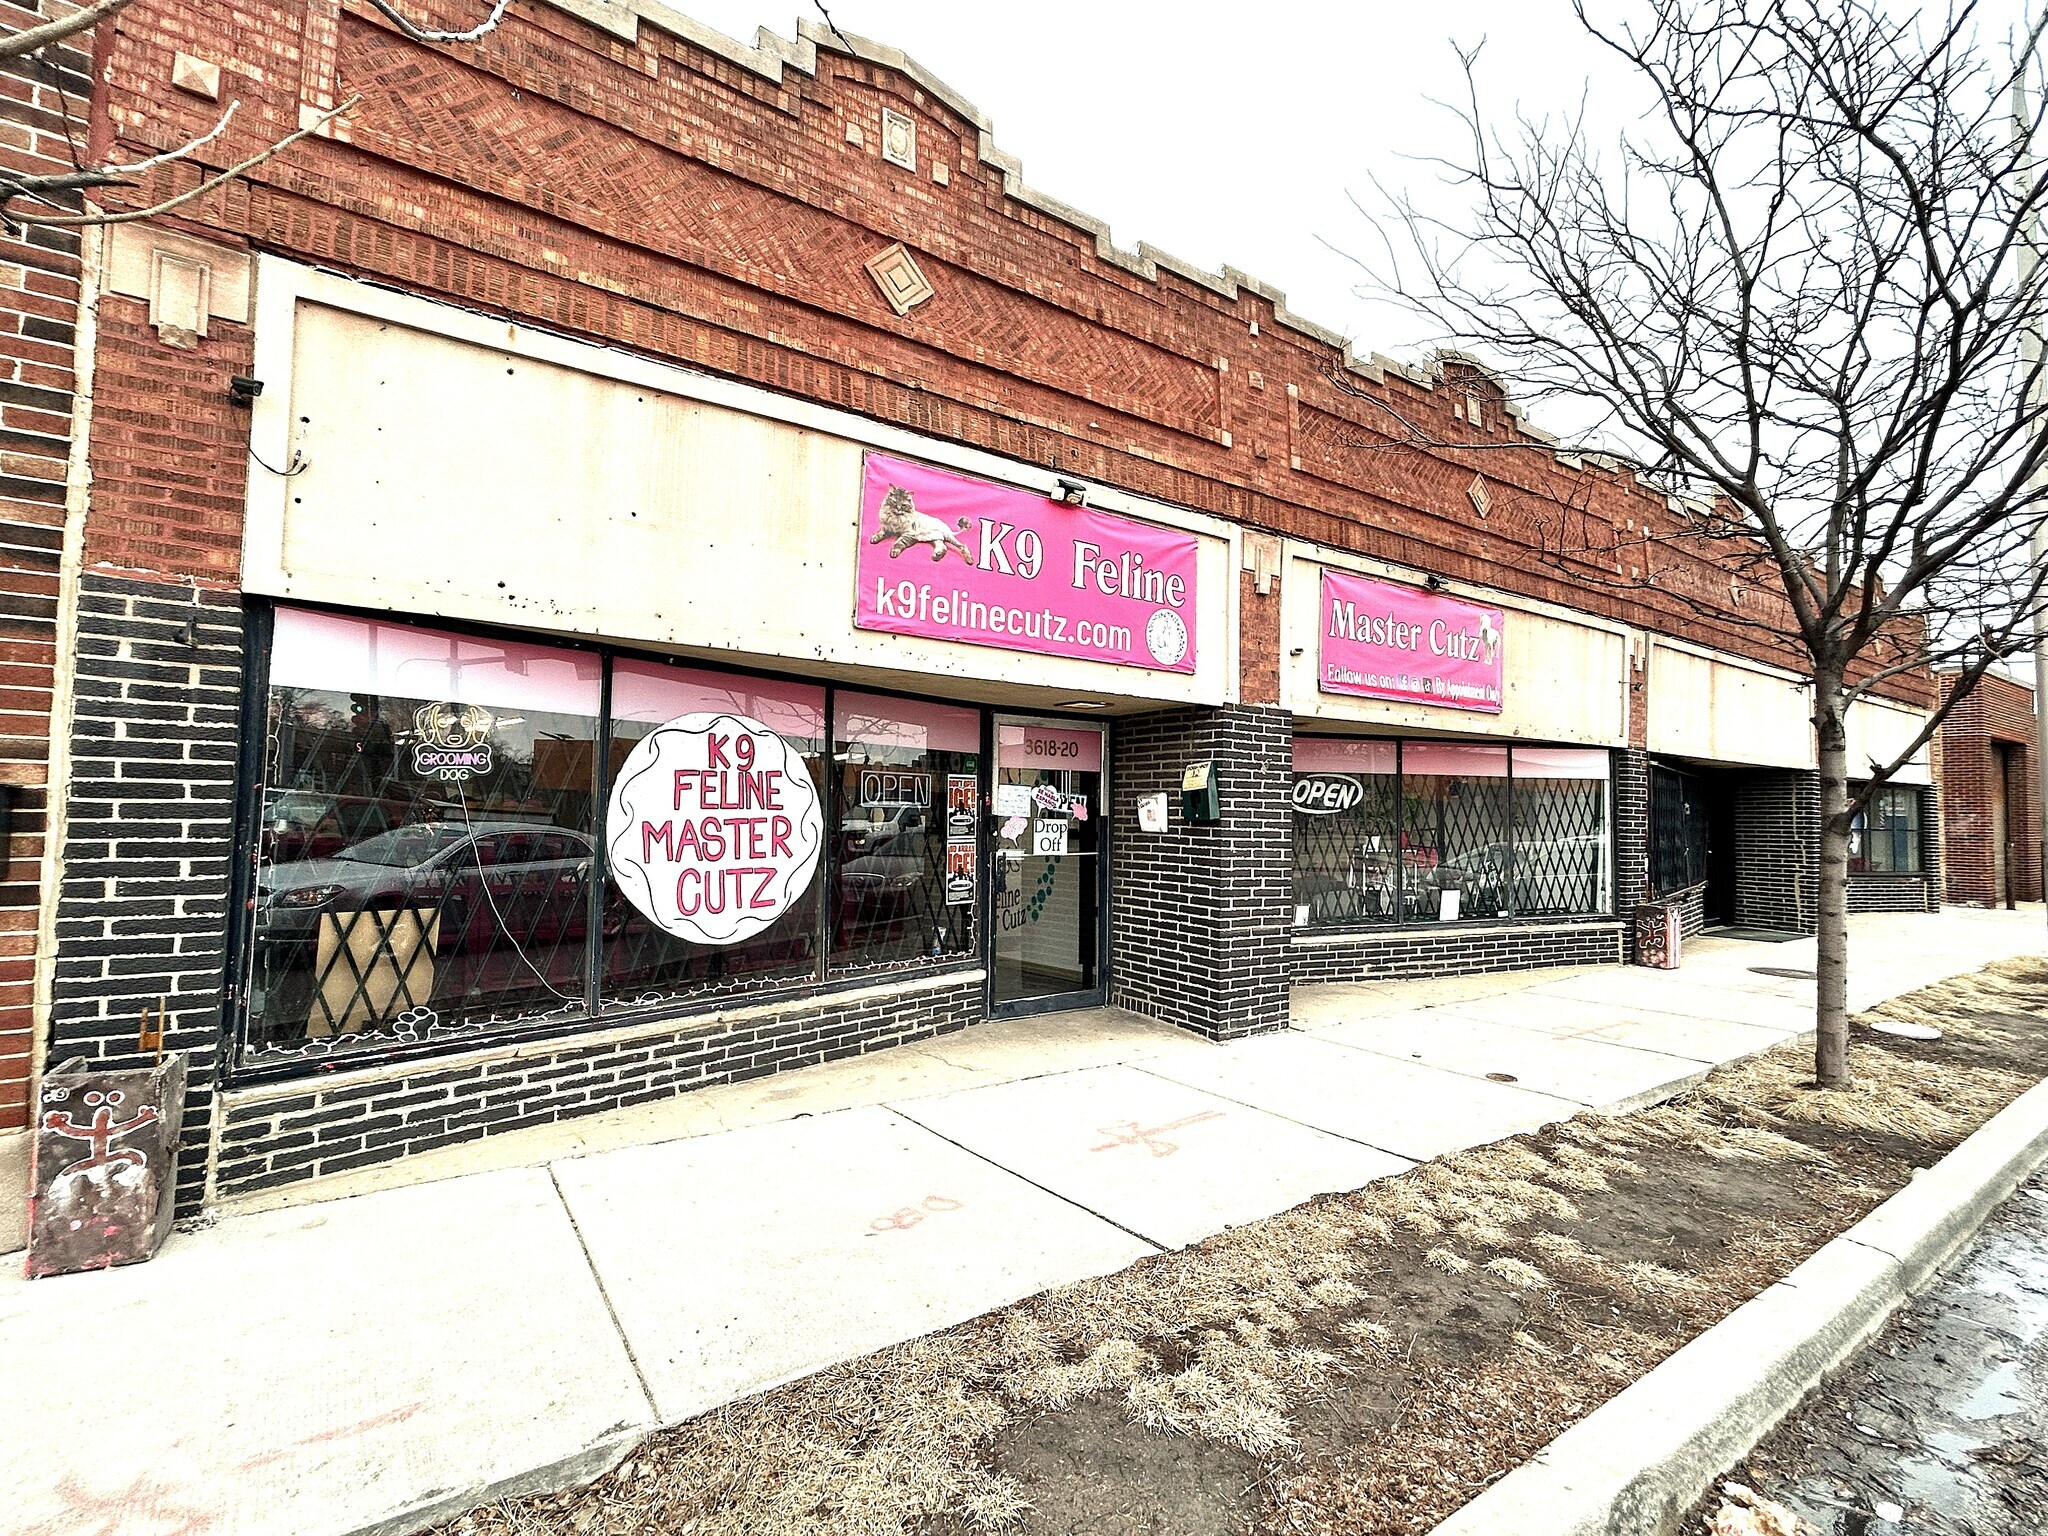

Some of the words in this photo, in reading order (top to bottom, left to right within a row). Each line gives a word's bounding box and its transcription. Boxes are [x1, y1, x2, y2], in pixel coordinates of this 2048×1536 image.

[976, 517, 1044, 580] K9
[1071, 539, 1187, 608] Feline
[875, 575, 1132, 652] k9felinecutz.com
[1328, 598, 1423, 651] Master
[1429, 619, 1480, 662] Cutz
[1326, 663, 1362, 685] Follow
[1364, 673, 1377, 687] us
[1379, 675, 1396, 690] on:
[420, 752, 487, 766] GROOMING
[708, 732, 755, 772] K9
[1024, 739, 1079, 758] 3618-20
[440, 768, 470, 780] DOG
[673, 769, 784, 811] FELINE
[864, 774, 929, 805] OPEN
[949, 787, 976, 809] ICE!
[1292, 778, 1357, 810] OPEN
[641, 815, 793, 864] MASTER
[1034, 818, 1067, 839] Drop
[1040, 837, 1061, 852] Off
[947, 852, 975, 875] ICE!
[676, 867, 778, 917] CUTZ
[1002, 908, 1028, 932] Cutz
